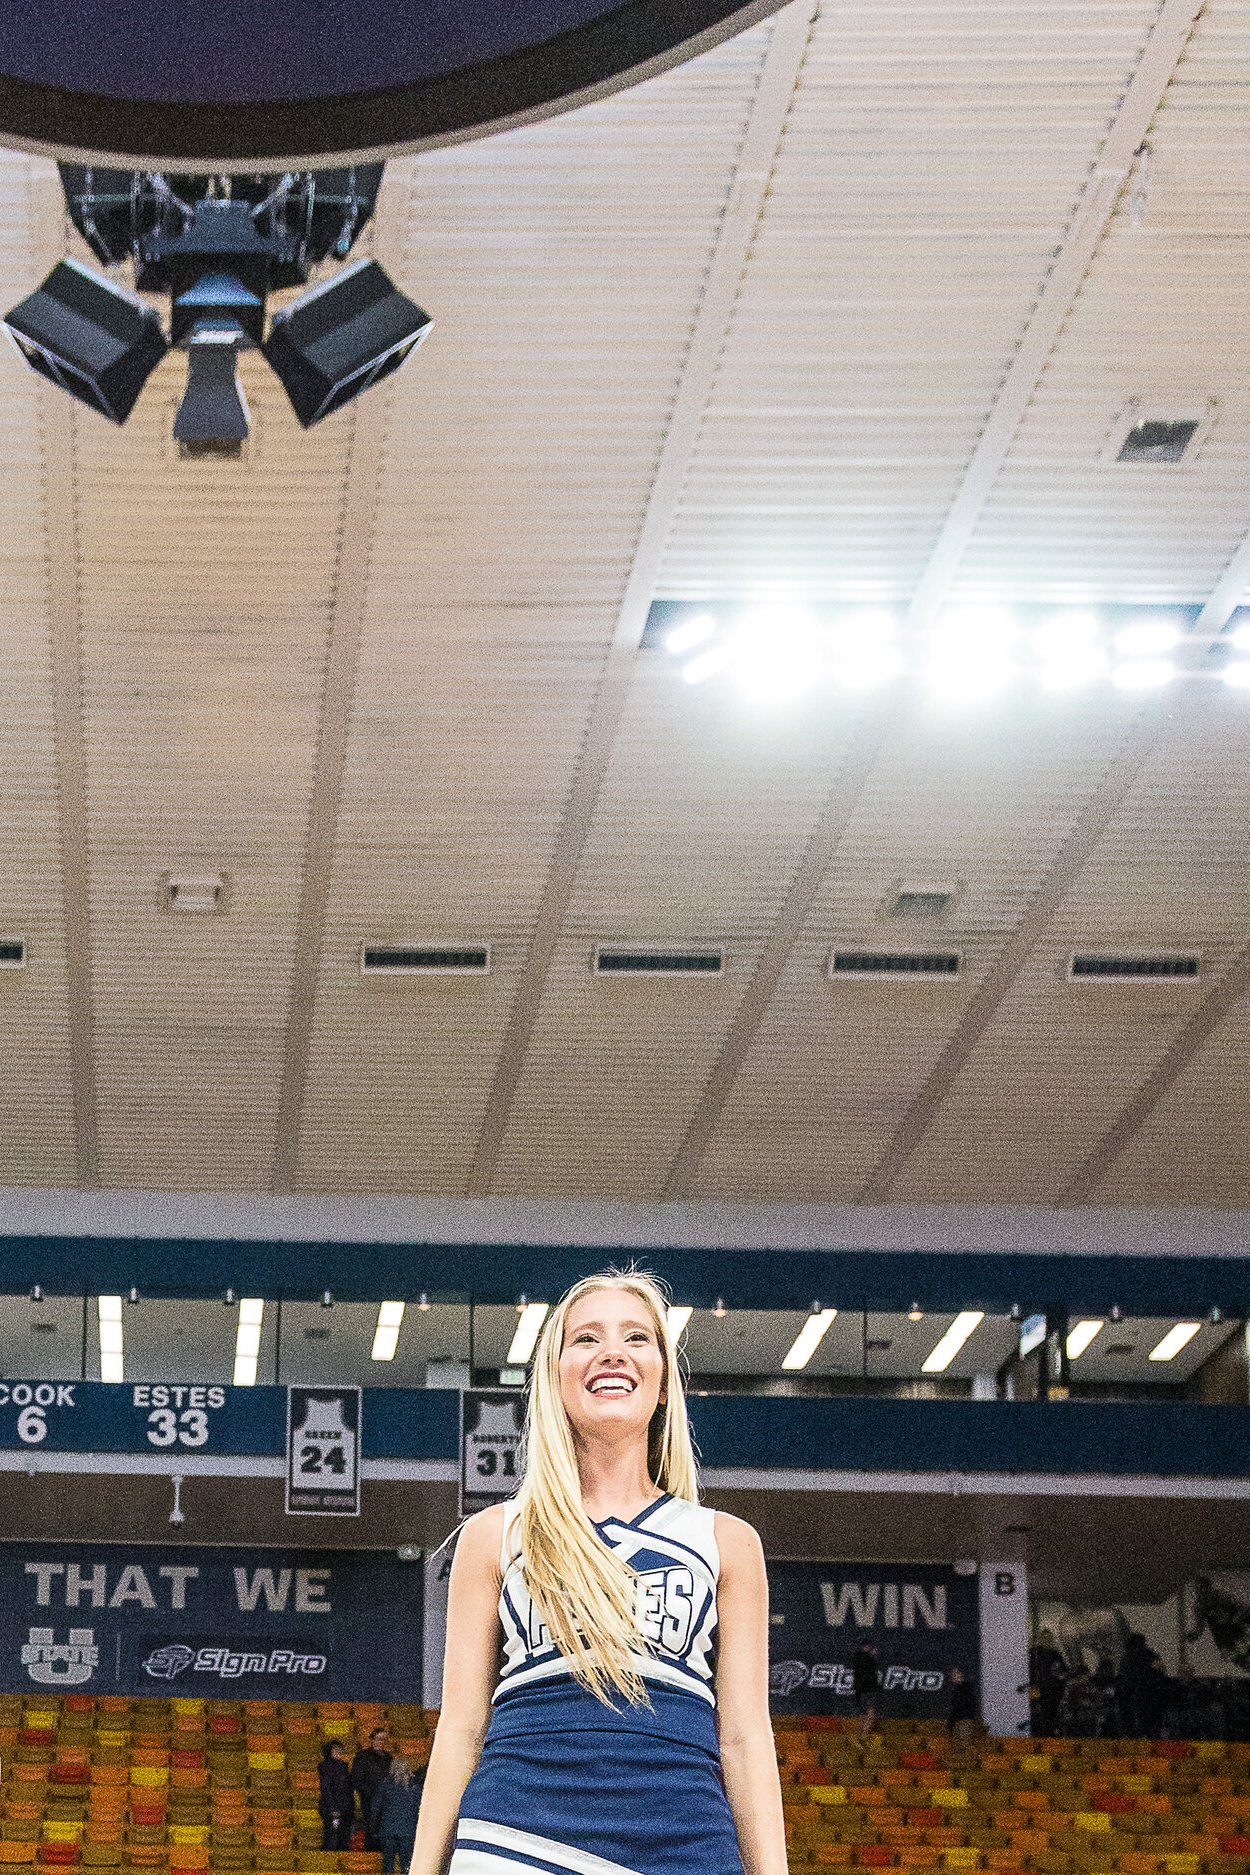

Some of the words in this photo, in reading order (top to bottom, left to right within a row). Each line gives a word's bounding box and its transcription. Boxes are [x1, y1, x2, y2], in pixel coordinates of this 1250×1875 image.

[133, 1385, 225, 1407] ESTES
[17, 1405, 48, 1443] 6
[146, 1409, 208, 1446] 33
[300, 1446, 346, 1474] 24
[477, 1450, 516, 1476] 31
[24, 1562, 199, 1609] THAT
[233, 1567, 332, 1612] WE
[994, 1572, 1015, 1596] B
[819, 1582, 947, 1628] WIN
[193, 1648, 266, 1678] Sign
[267, 1650, 327, 1673] Pro
[882, 1666, 944, 1691] Pro
